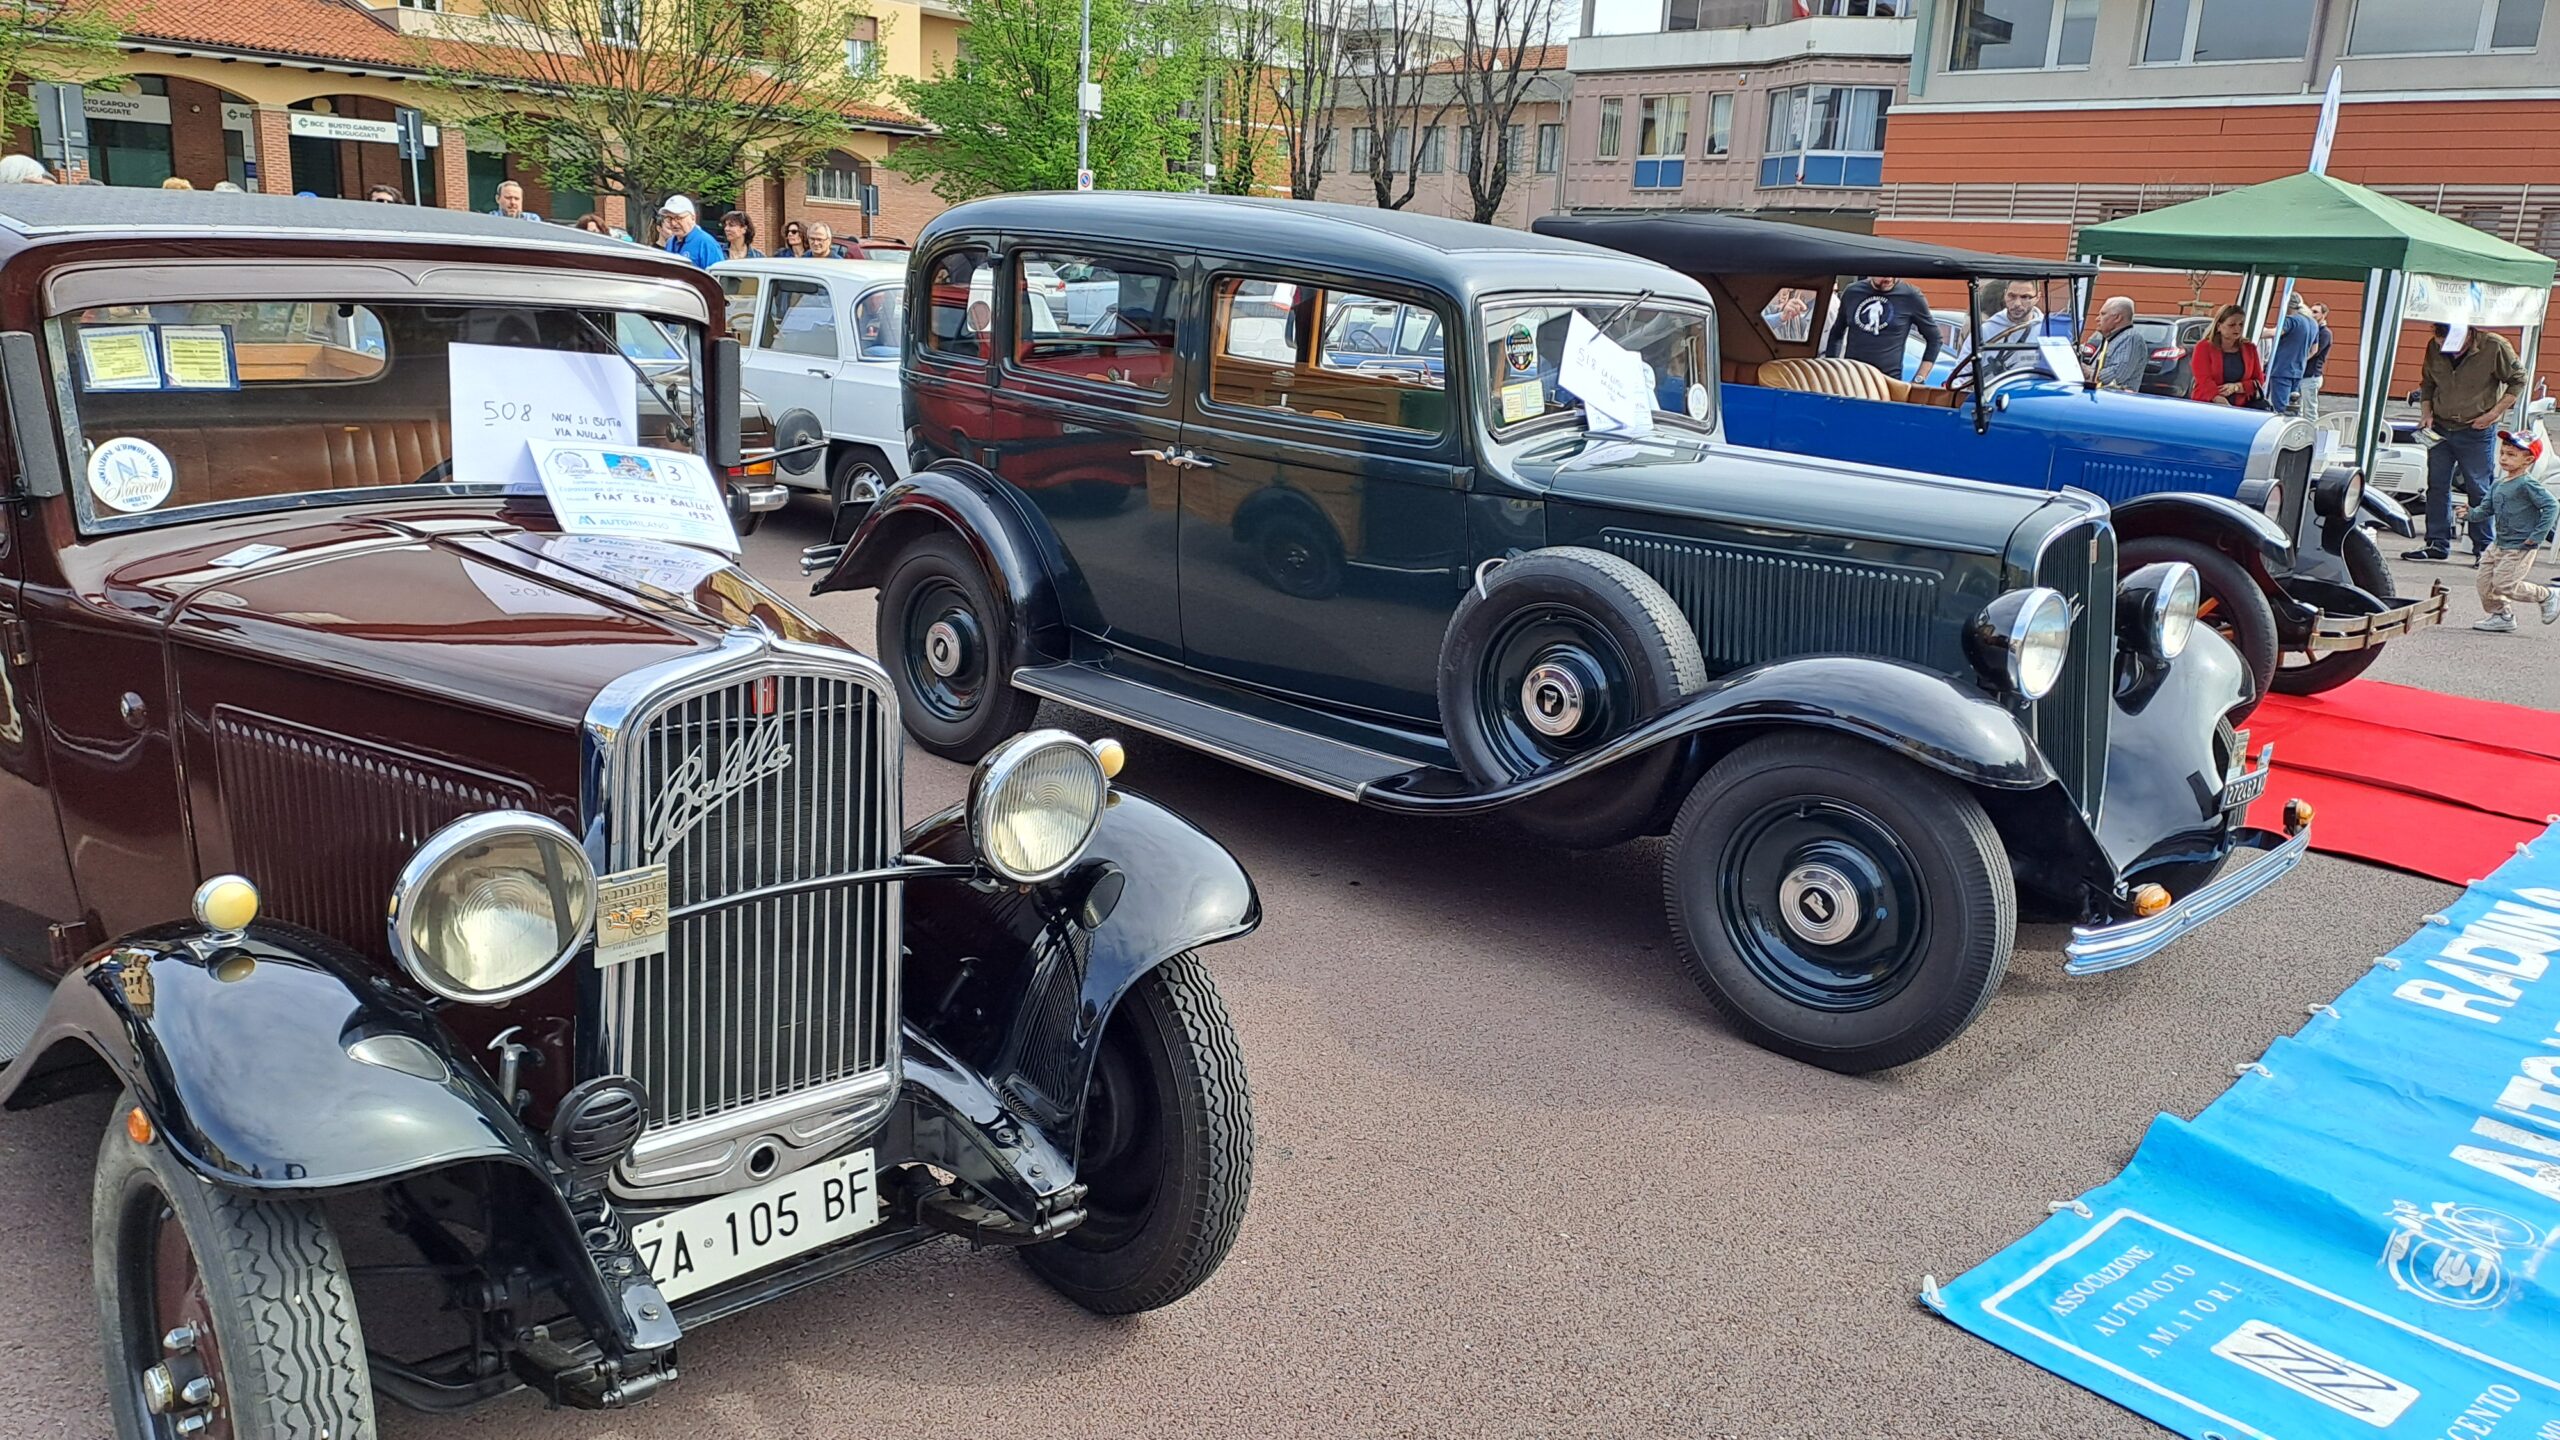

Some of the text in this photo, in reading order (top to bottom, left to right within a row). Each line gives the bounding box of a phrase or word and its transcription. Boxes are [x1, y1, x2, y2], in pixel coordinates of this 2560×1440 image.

[84, 106, 132, 115] UGUGGIATE
[100, 100, 139, 109] GAROLFO
[328, 122, 352, 130] BUSTO
[353, 124, 386, 133] GAROLFO
[484, 400, 622, 428] 508 NON SI BUTTA
[554, 427, 572, 437] VIA
[668, 465, 682, 482] 3
[594, 493, 624, 502] FIAT
[644, 718, 793, 853] Balilla
[640, 1167, 869, 1285] ZA 105 BF
[2049, 1245, 2155, 1317] ASSOCIAZIONE
[2092, 1264, 2197, 1337] AUTOMOTO
[2138, 1281, 2243, 1358] AMATORI
[2437, 1384, 2521, 1440] CENTO
